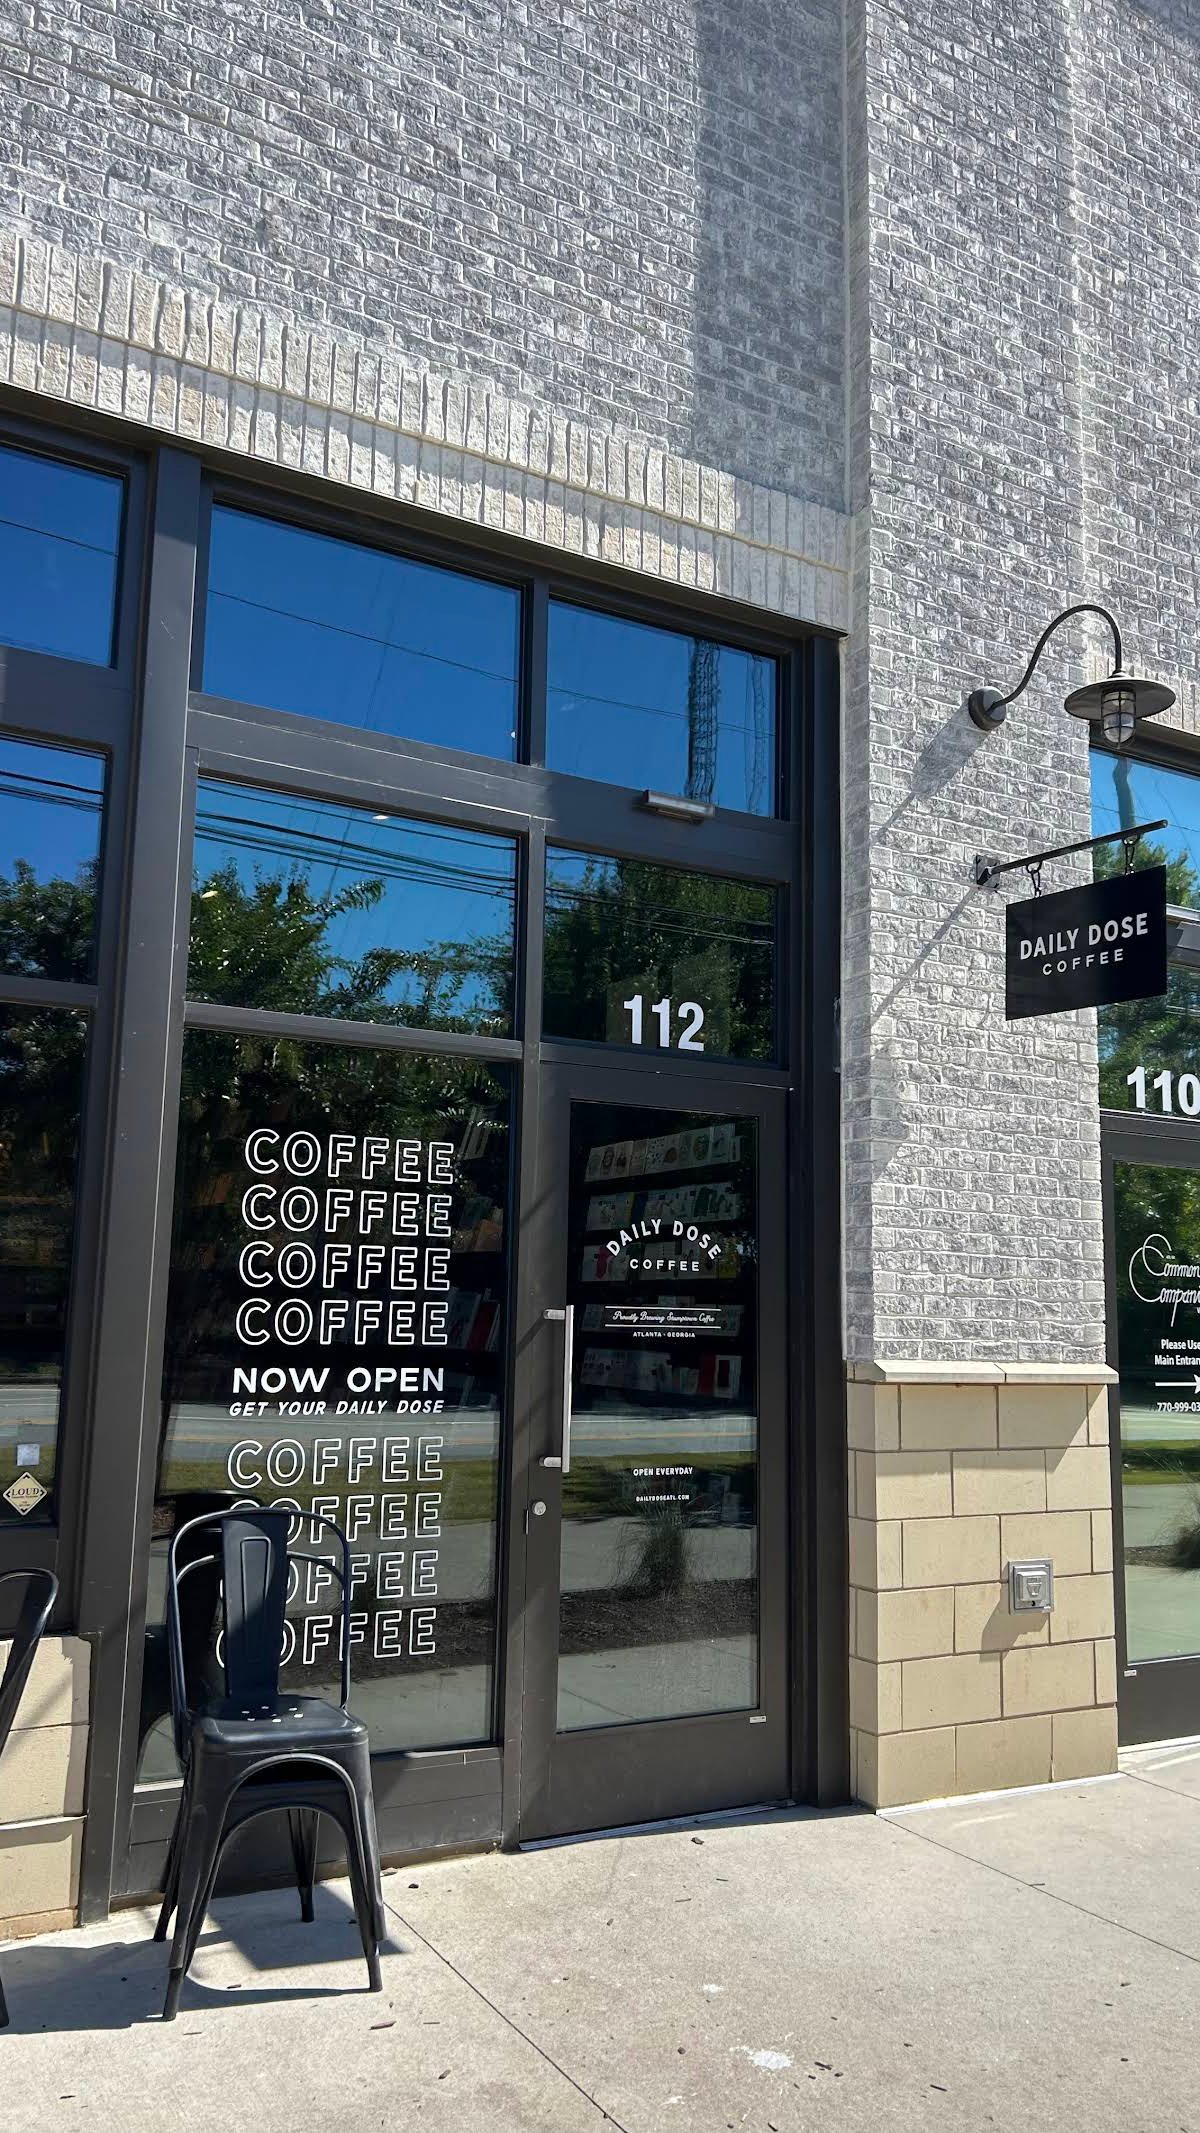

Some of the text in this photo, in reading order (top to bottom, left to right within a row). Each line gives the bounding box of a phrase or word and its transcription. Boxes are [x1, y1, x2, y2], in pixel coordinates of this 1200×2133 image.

[1020, 912, 1148, 960] DAILY DOSE
[1042, 948, 1124, 976] COFFEE
[623, 994, 704, 1052] 112
[1127, 1065, 1200, 1116] 110
[244, 1128, 454, 1184] COFFEE
[241, 1183, 452, 1237] COFFEE
[606, 1218, 722, 1260] DAILY DOSE
[239, 1241, 451, 1291] COFFEE
[630, 1258, 700, 1272] COFFEE
[235, 1298, 449, 1346] COFFEE
[698, 1313, 715, 1323] Coffee
[1154, 1354, 1175, 1366] Main
[1161, 1338, 1200, 1350] Please Use
[232, 1366, 445, 1394] NOW OPEN
[229, 1399, 445, 1416] GET YOUR DAILY DOSE
[227, 1436, 444, 1489] COFFEE
[633, 1466, 693, 1477] OPEN EVERYDAY
